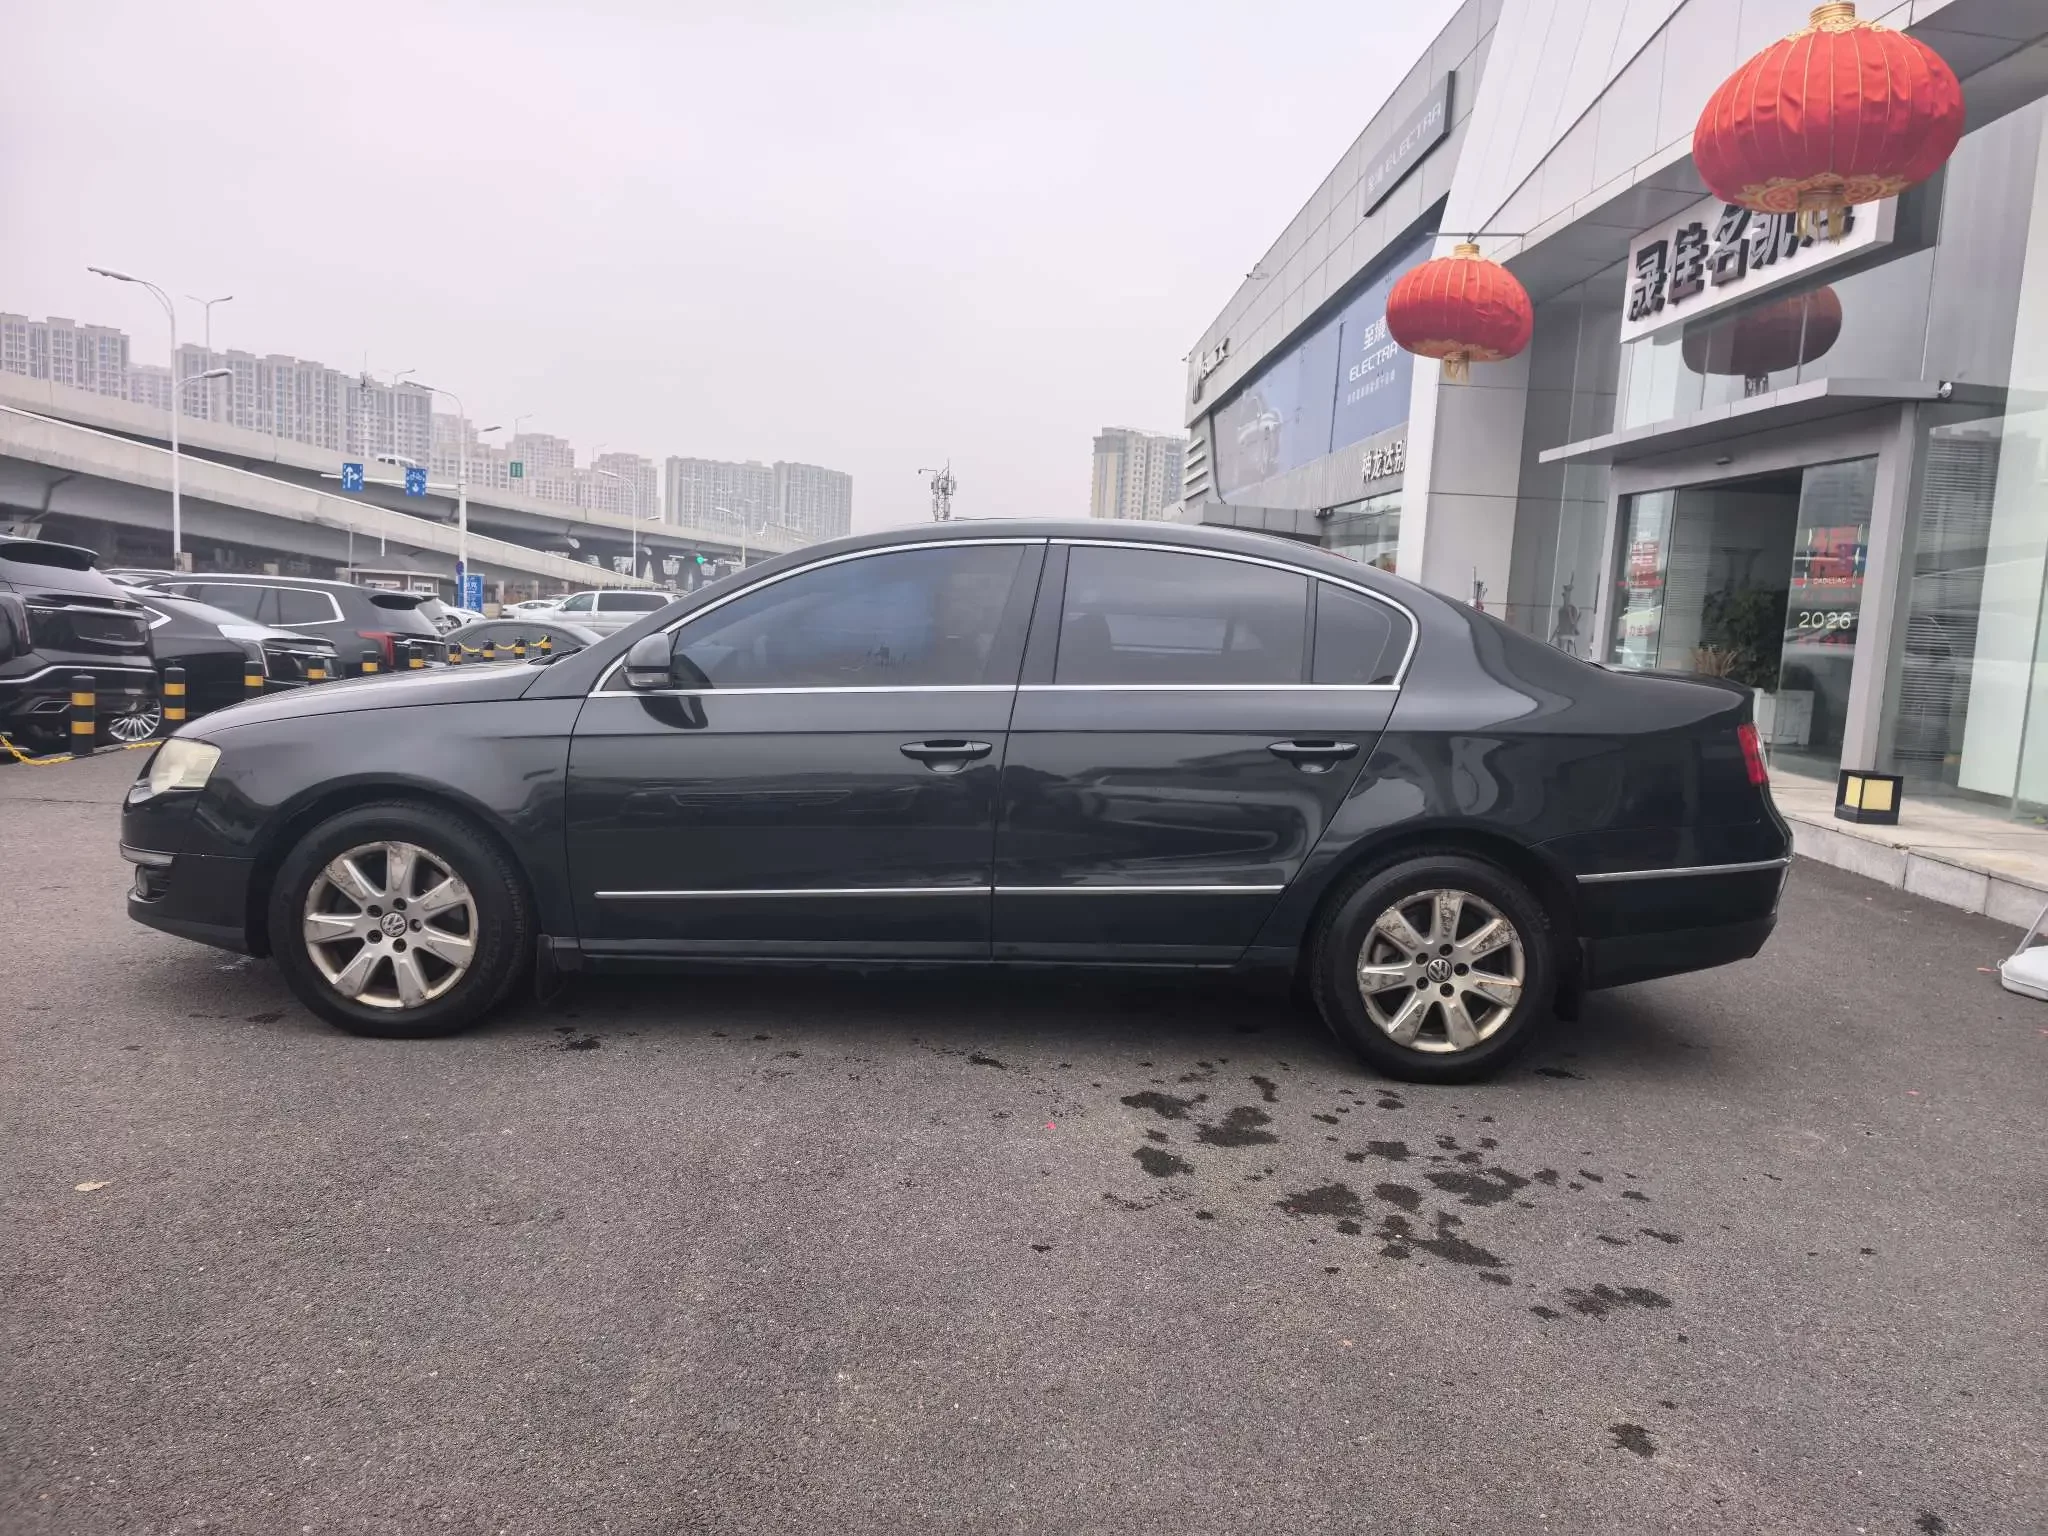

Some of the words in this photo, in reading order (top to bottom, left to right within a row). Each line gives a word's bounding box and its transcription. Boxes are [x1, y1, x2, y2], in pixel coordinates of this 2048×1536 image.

[1385, 102, 1441, 173] ELECTRA
[1349, 340, 1398, 382] ELECTRA
[1799, 611, 1852, 630] 2026
